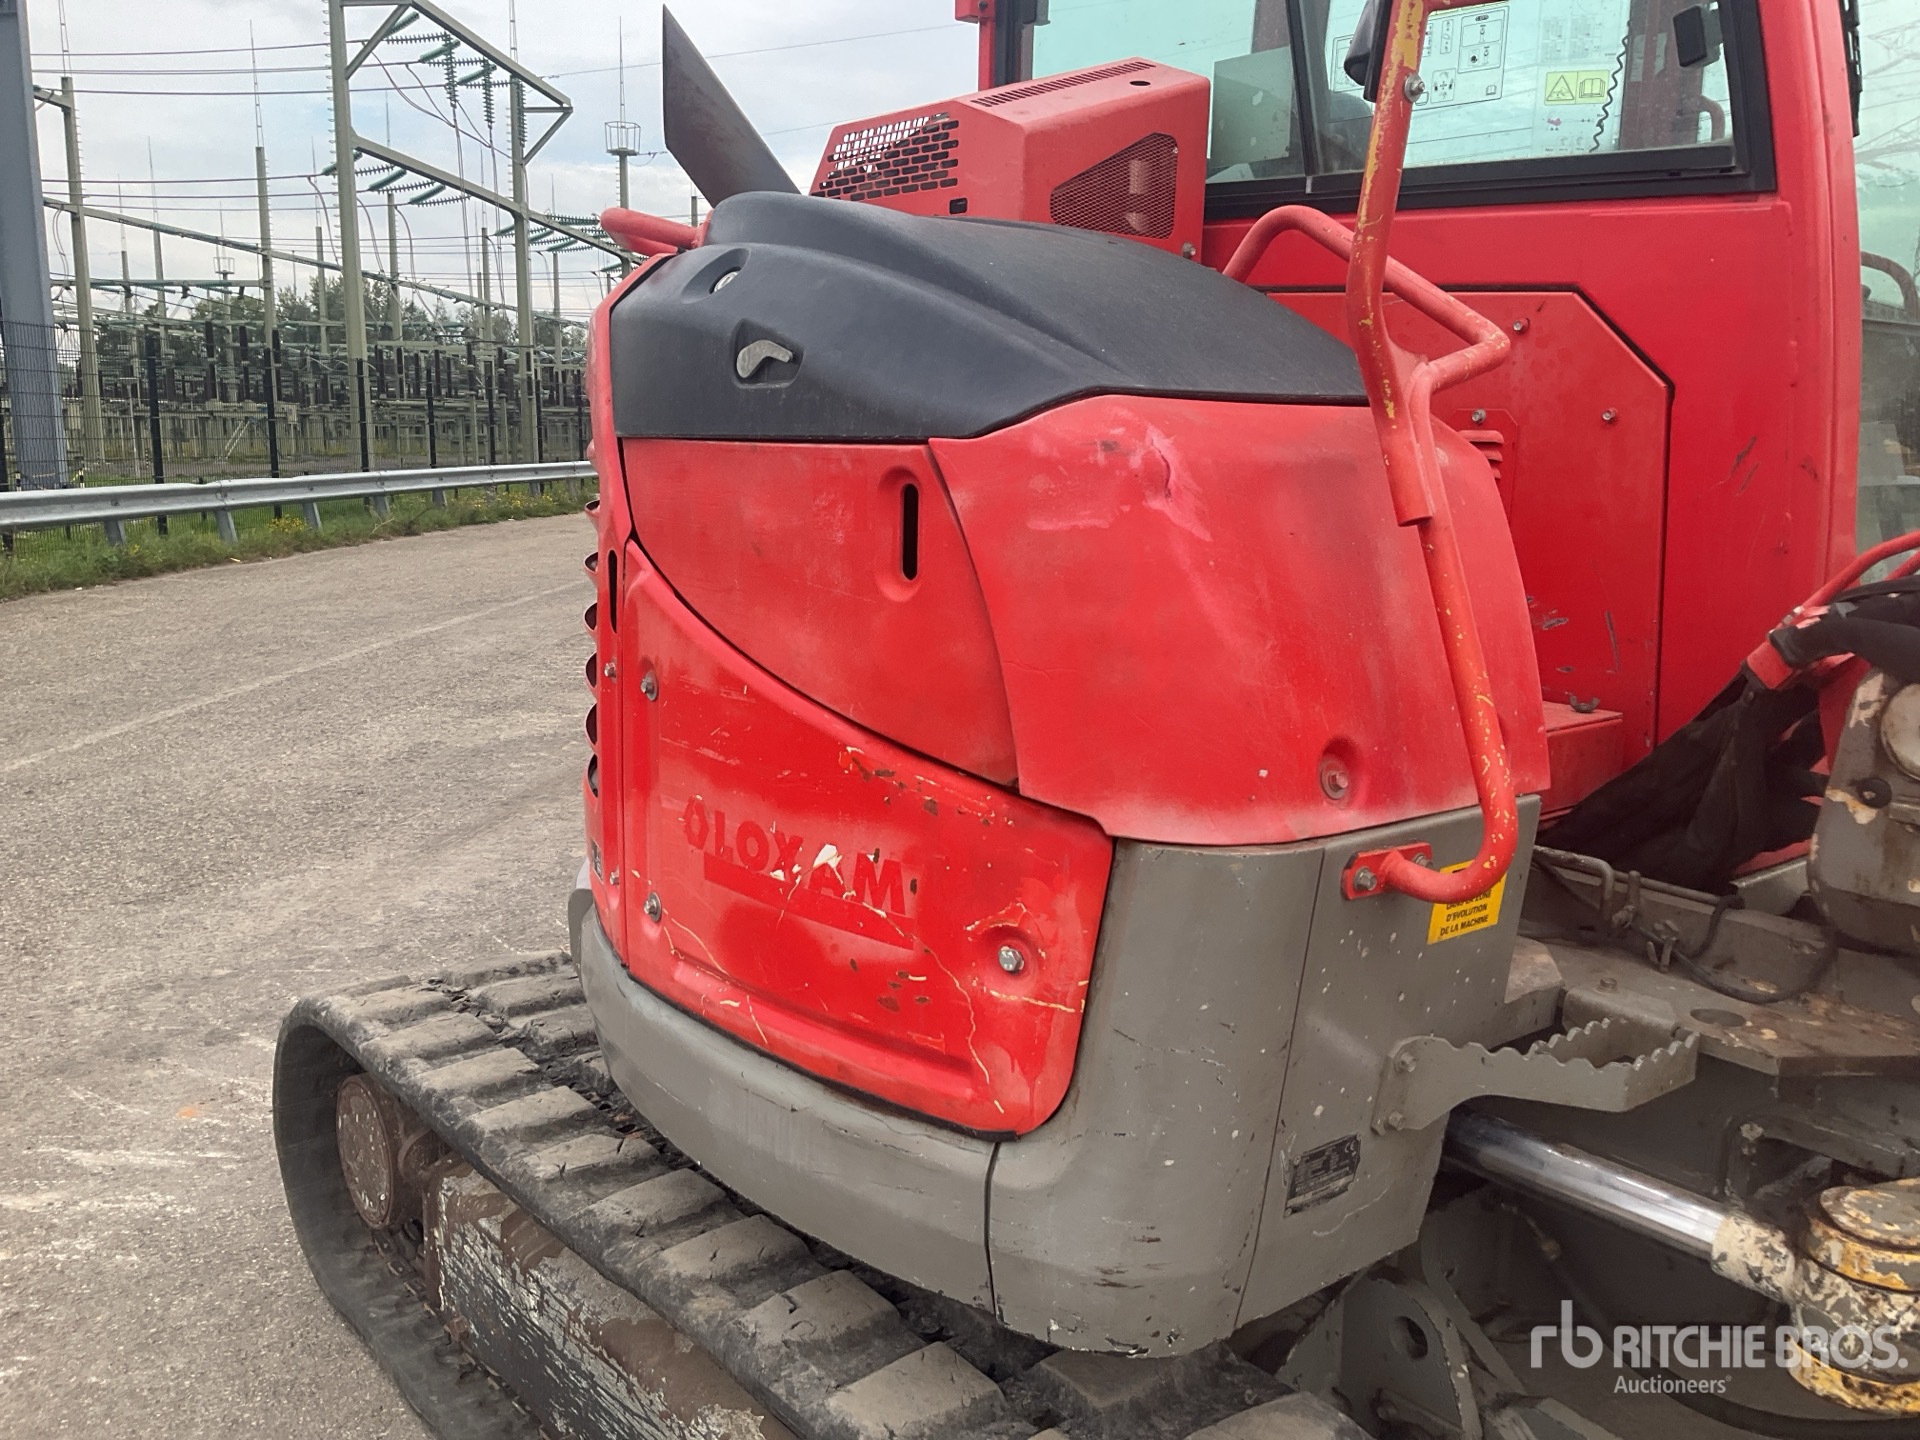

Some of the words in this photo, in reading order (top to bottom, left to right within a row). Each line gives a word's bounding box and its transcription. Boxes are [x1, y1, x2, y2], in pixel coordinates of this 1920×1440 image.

[713, 809, 907, 915] LOXAM
[1440, 926, 1450, 936] DE
[1450, 923, 1459, 932] LA
[1460, 914, 1489, 929] MACHINE
